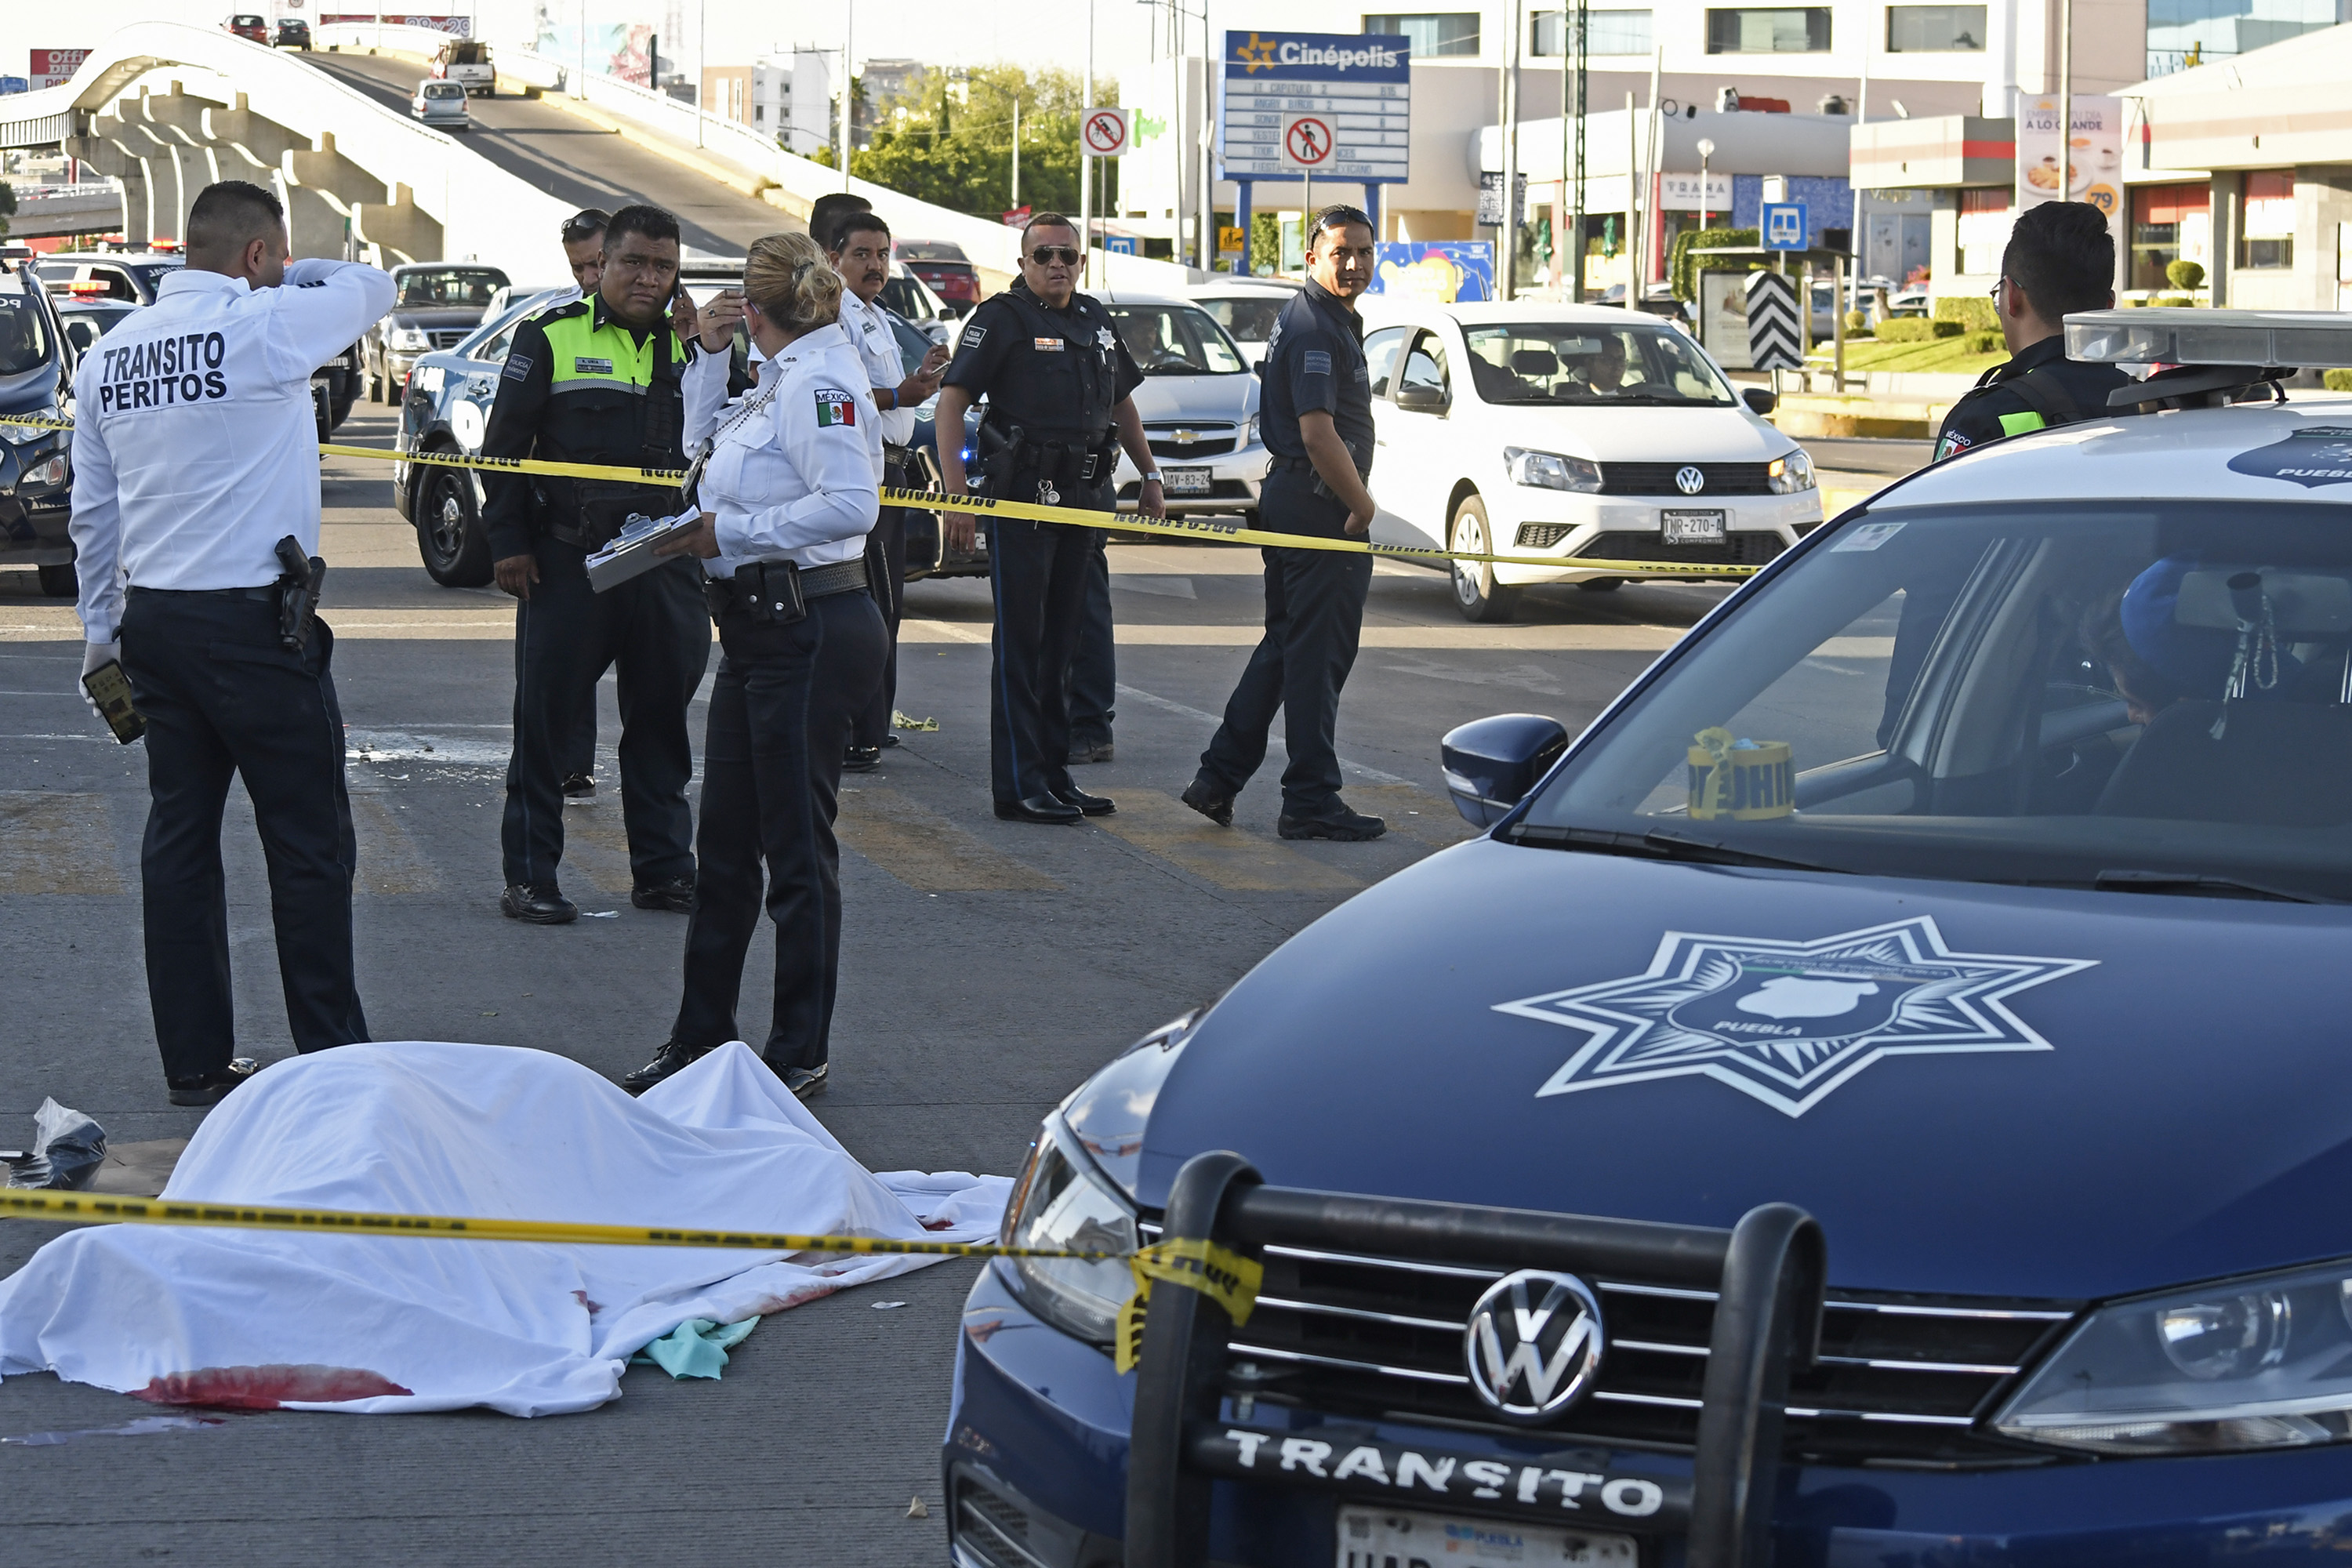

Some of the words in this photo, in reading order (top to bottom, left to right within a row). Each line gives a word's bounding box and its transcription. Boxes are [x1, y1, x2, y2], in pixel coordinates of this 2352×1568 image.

[48, 50, 85, 64] Offi
[1279, 42, 1398, 71] Cinépolis
[48, 64, 79, 74] DEP
[2026, 121, 2034, 129] A
[2038, 121, 2053, 129] LO
[2091, 192, 2113, 209] 79
[103, 332, 225, 383] TRANSITO
[100, 371, 227, 412] PERITOS
[817, 390, 852, 401] MÉXICO
[1663, 518, 1723, 534] TNR-270-A
[1713, 1021, 1802, 1036] PUEBLA
[1225, 1429, 1663, 1516] TRANSITO
